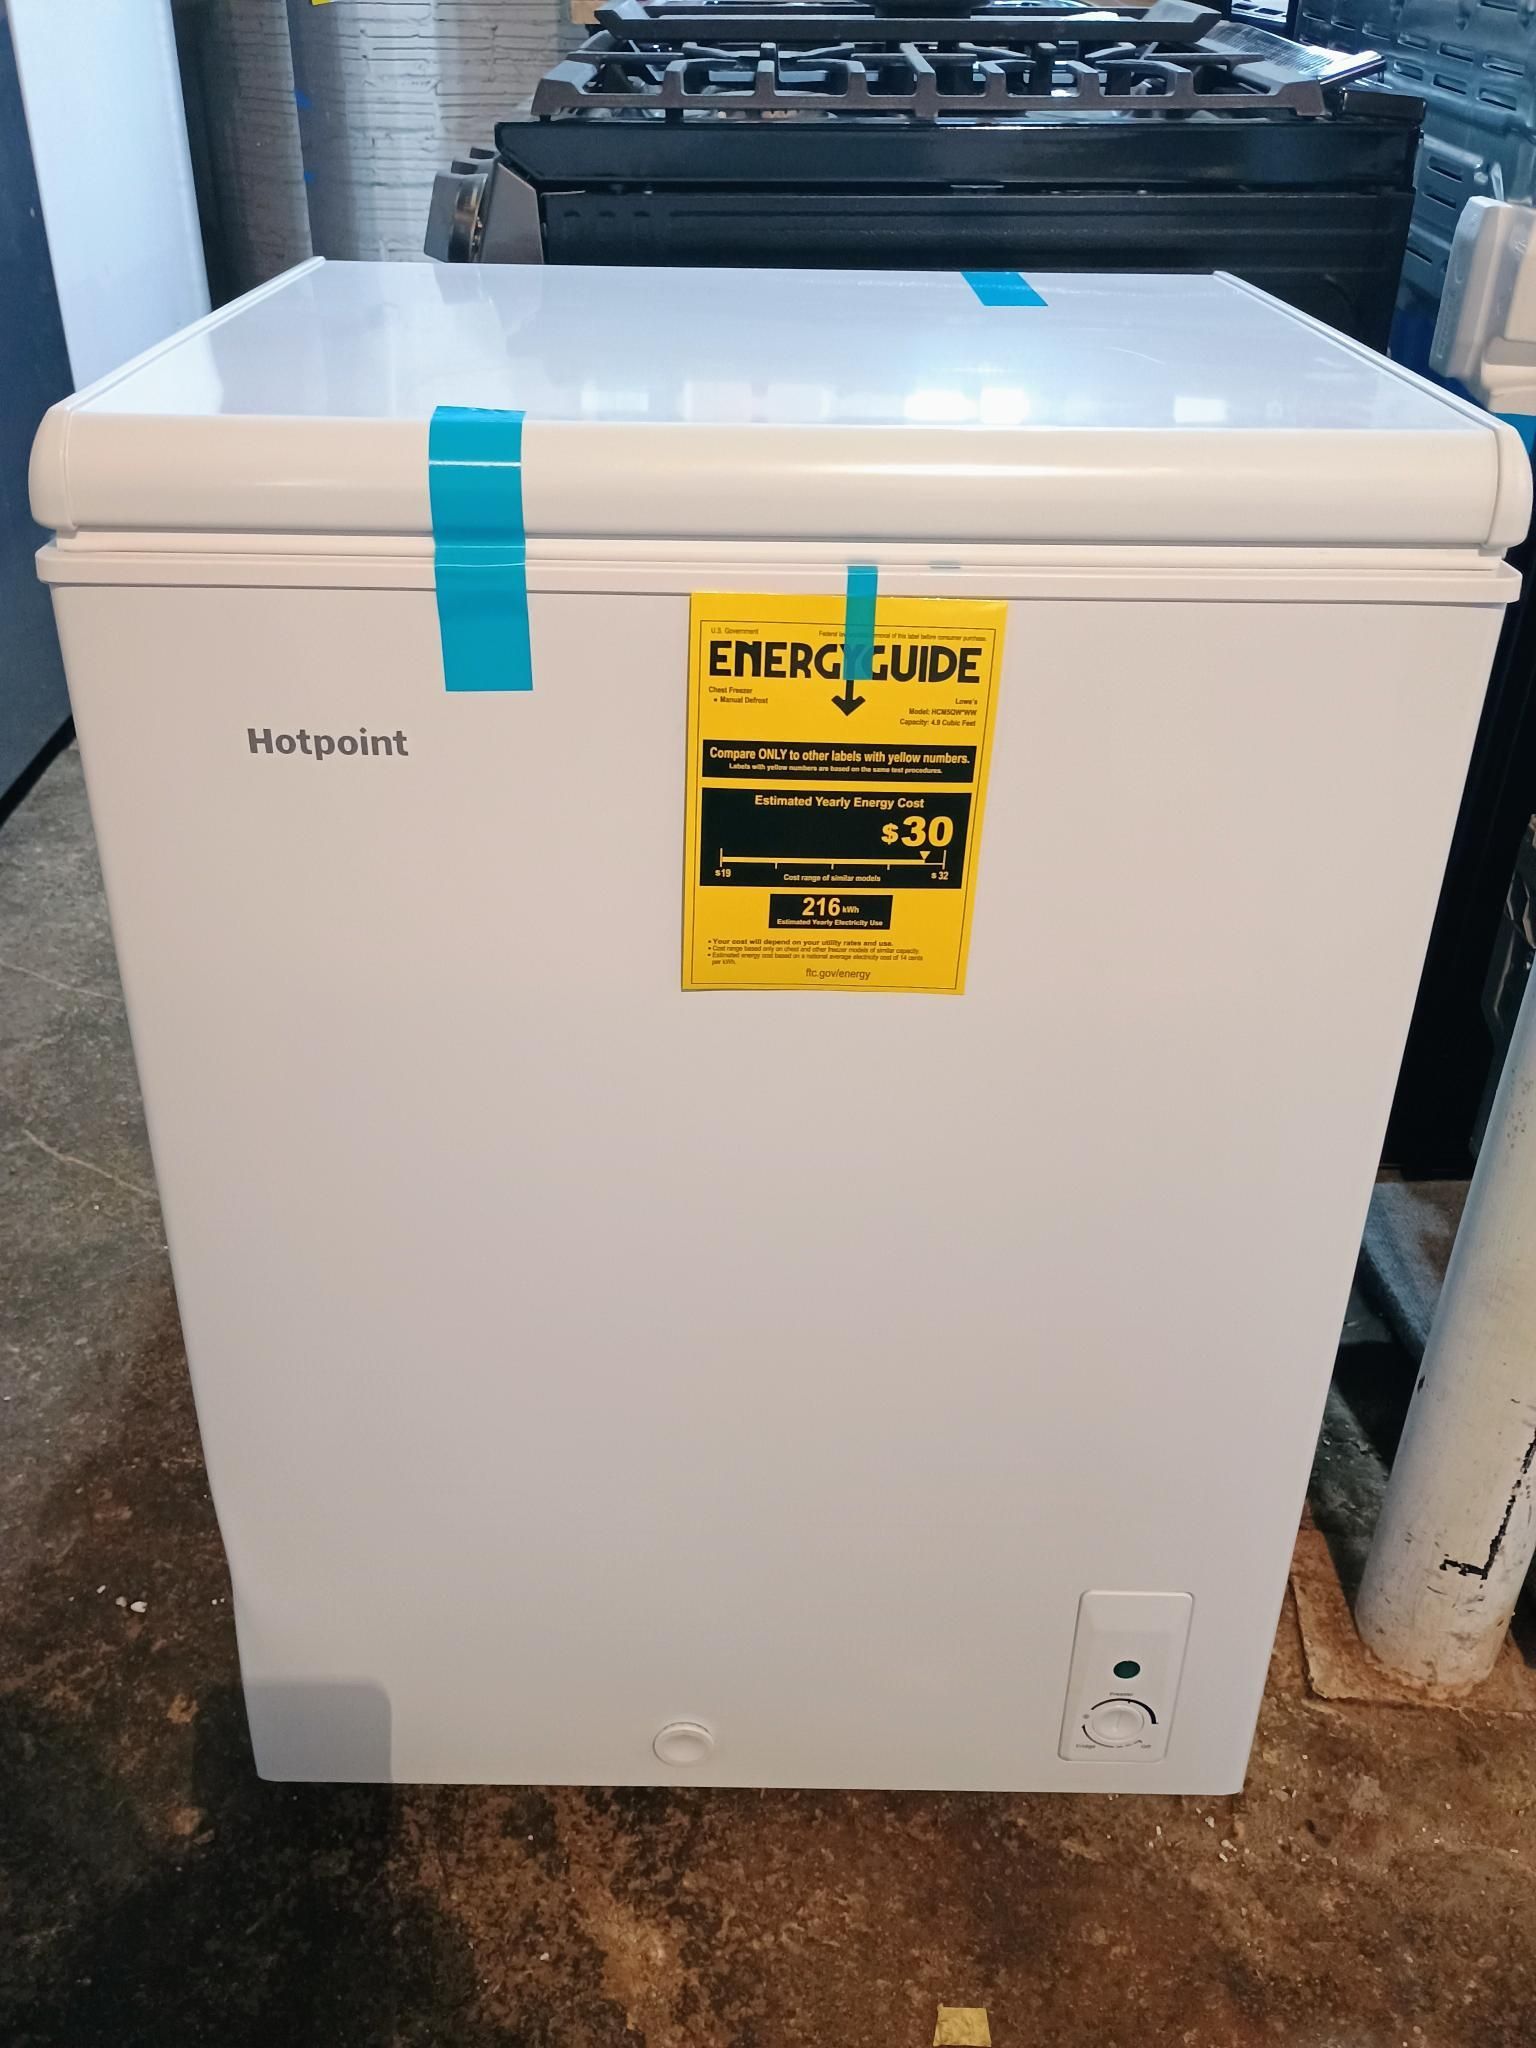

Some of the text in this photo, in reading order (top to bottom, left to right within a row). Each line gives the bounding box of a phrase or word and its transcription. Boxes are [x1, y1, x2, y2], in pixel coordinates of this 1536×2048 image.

[709, 686, 728, 694] Chest
[745, 696, 768, 704] Defrost
[900, 718, 929, 727] Capacity:
[247, 727, 409, 760] Hotpoint
[710, 746, 970, 765] Compare ONLY to other labels with yellow numbers.
[905, 767, 943, 775] procedures.
[755, 795, 925, 810] Estimated Yearly Energy Cost
[881, 816, 954, 847] $30
[783, 873, 800, 881] Cost
[802, 897, 860, 917] 216 kWh
[812, 919, 833, 927] Yearly
[834, 919, 868, 927] Electricity
[822, 939, 841, 947] utility
[806, 968, 871, 980] ftc.gov/energy
